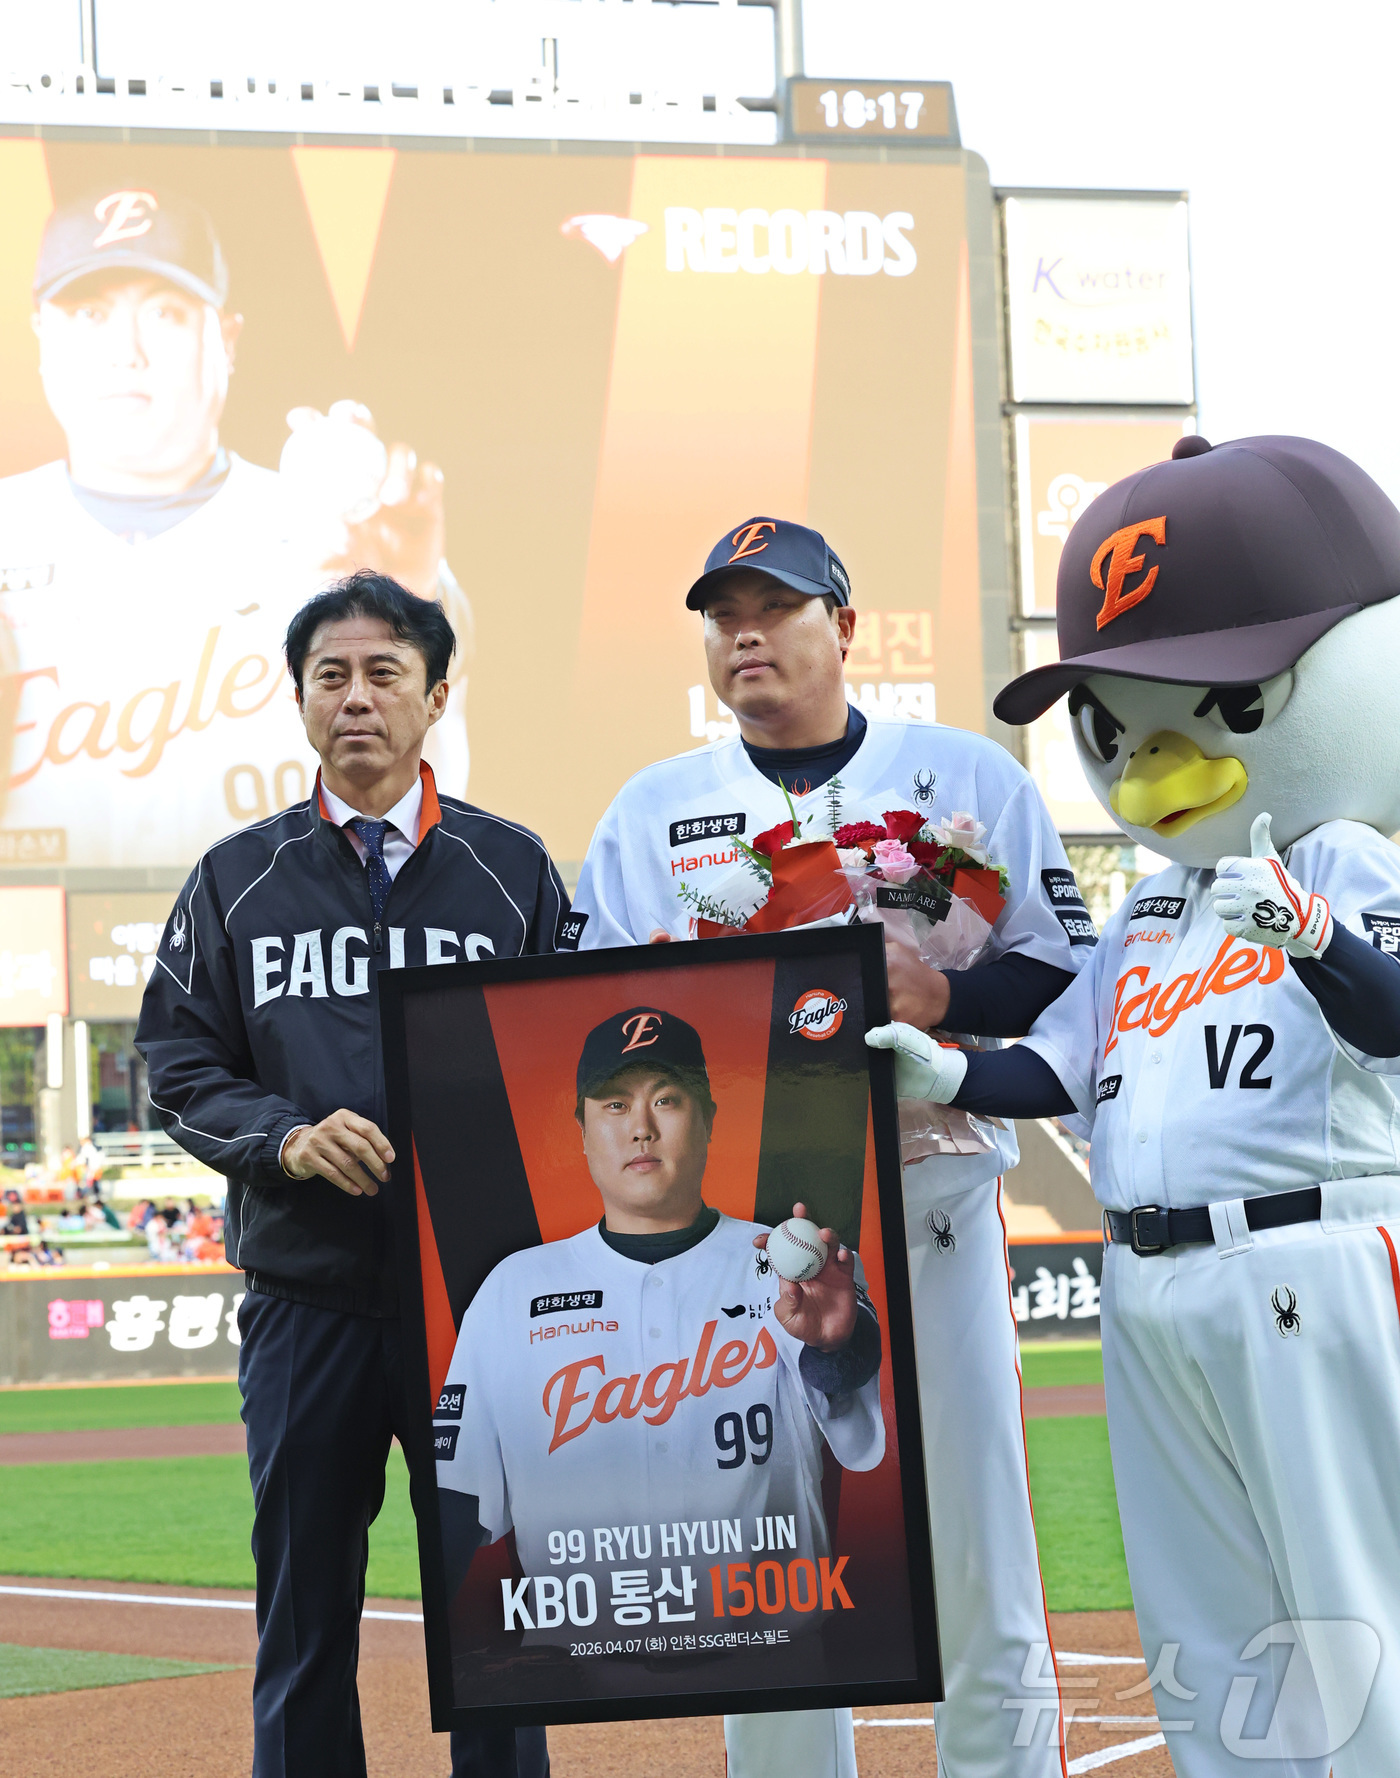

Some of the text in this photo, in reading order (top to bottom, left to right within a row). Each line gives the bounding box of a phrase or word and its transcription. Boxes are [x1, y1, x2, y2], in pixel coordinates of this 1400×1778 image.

[664, 207, 917, 277] RECORDS
[728, 522, 776, 564] E
[1089, 515, 1167, 632] E
[0, 625, 297, 792] Eagle
[675, 817, 739, 840] 한화생명
[671, 847, 752, 877] Hanw
[1131, 899, 1182, 917] 한화생명
[621, 1012, 663, 1055] E
[788, 996, 848, 1034] Eagles
[1204, 1023, 1275, 1090] V2
[536, 1293, 597, 1312] 한화생명
[529, 1318, 619, 1345] Hanwha
[435, 1393, 462, 1412] 오션
[543, 1319, 778, 1456] Eagles
[714, 1403, 774, 1470] 99
[547, 1514, 797, 1565] 99 RYU HYUN JIN
[500, 1555, 855, 1631] KBO 통산 1500K
[570, 1628, 791, 1656] 2026.04.07 (화) 인천 SSG랜더스필드
